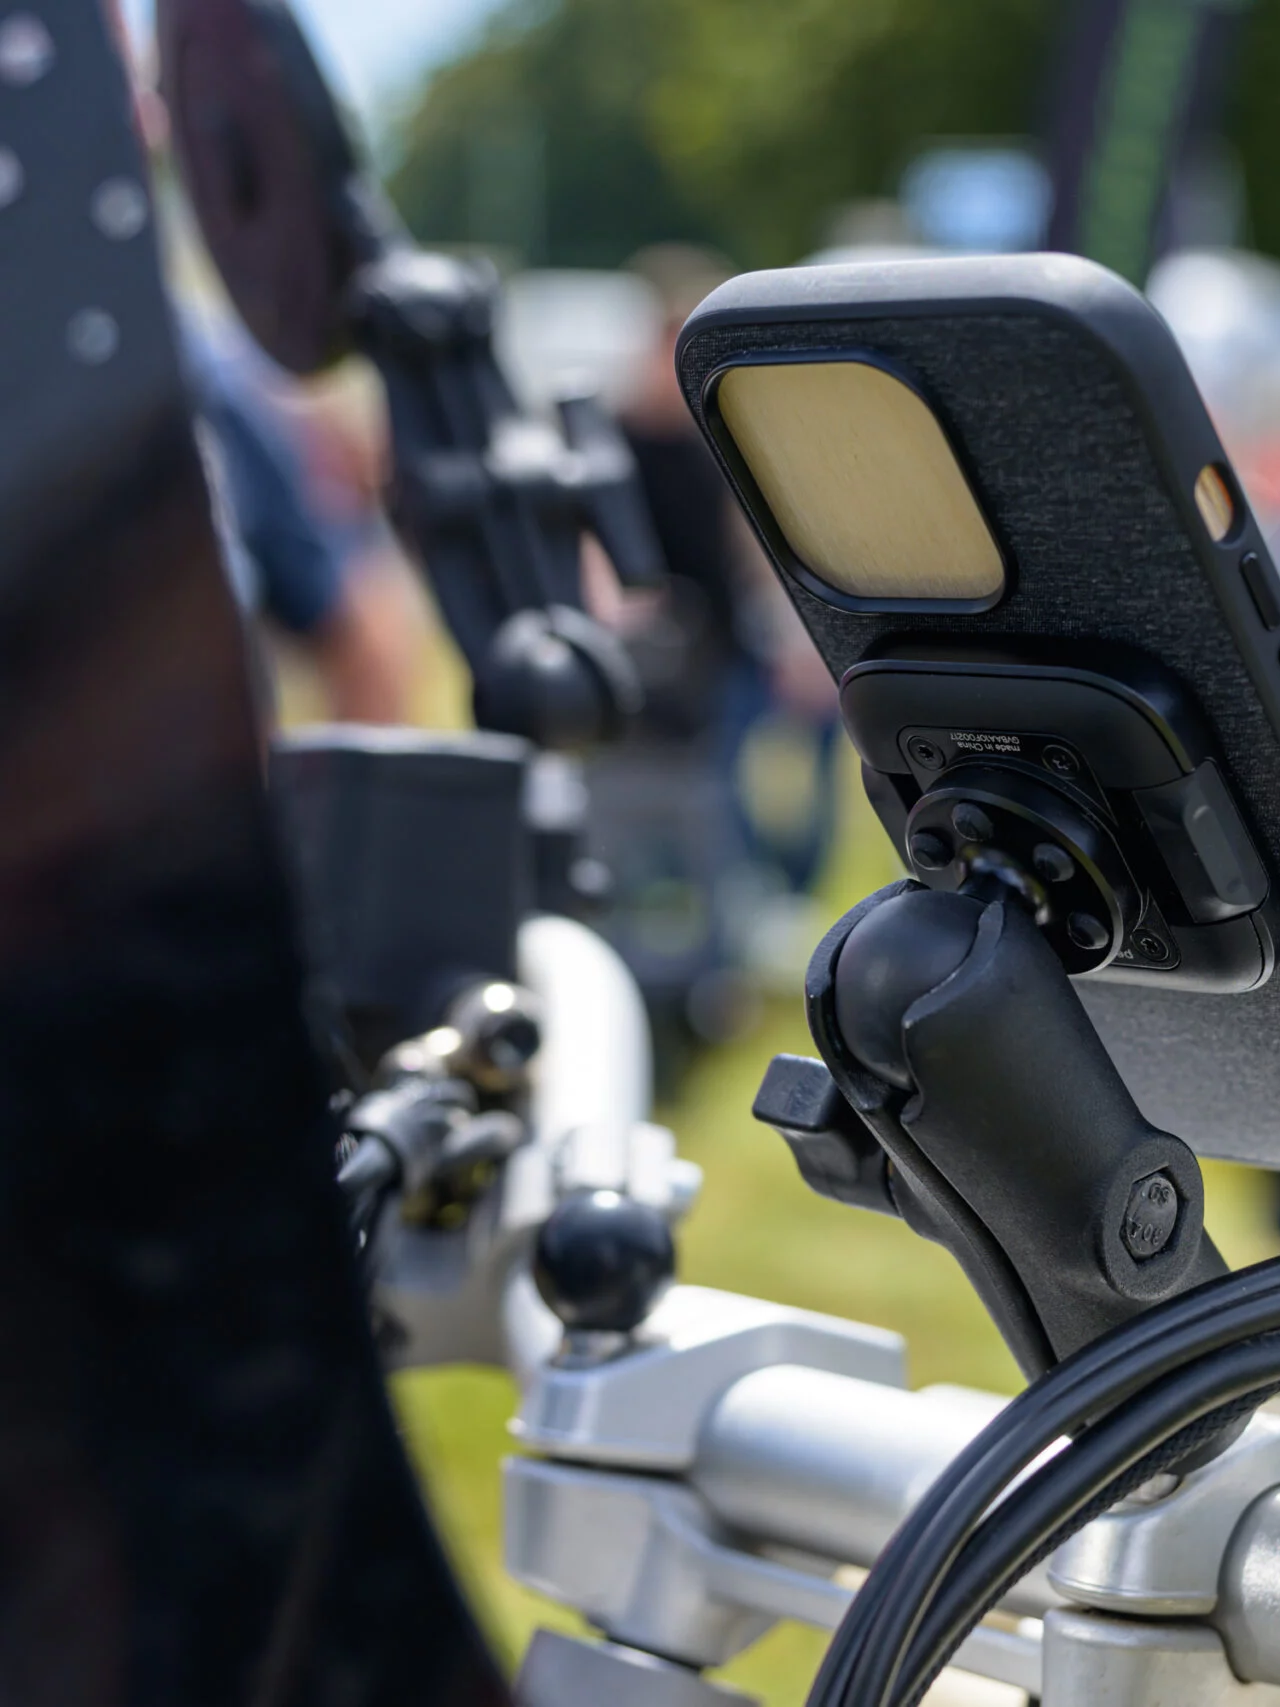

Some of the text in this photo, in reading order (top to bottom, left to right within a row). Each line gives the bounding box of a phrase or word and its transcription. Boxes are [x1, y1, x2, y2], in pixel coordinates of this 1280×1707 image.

[957, 741, 1020, 752] made in China
